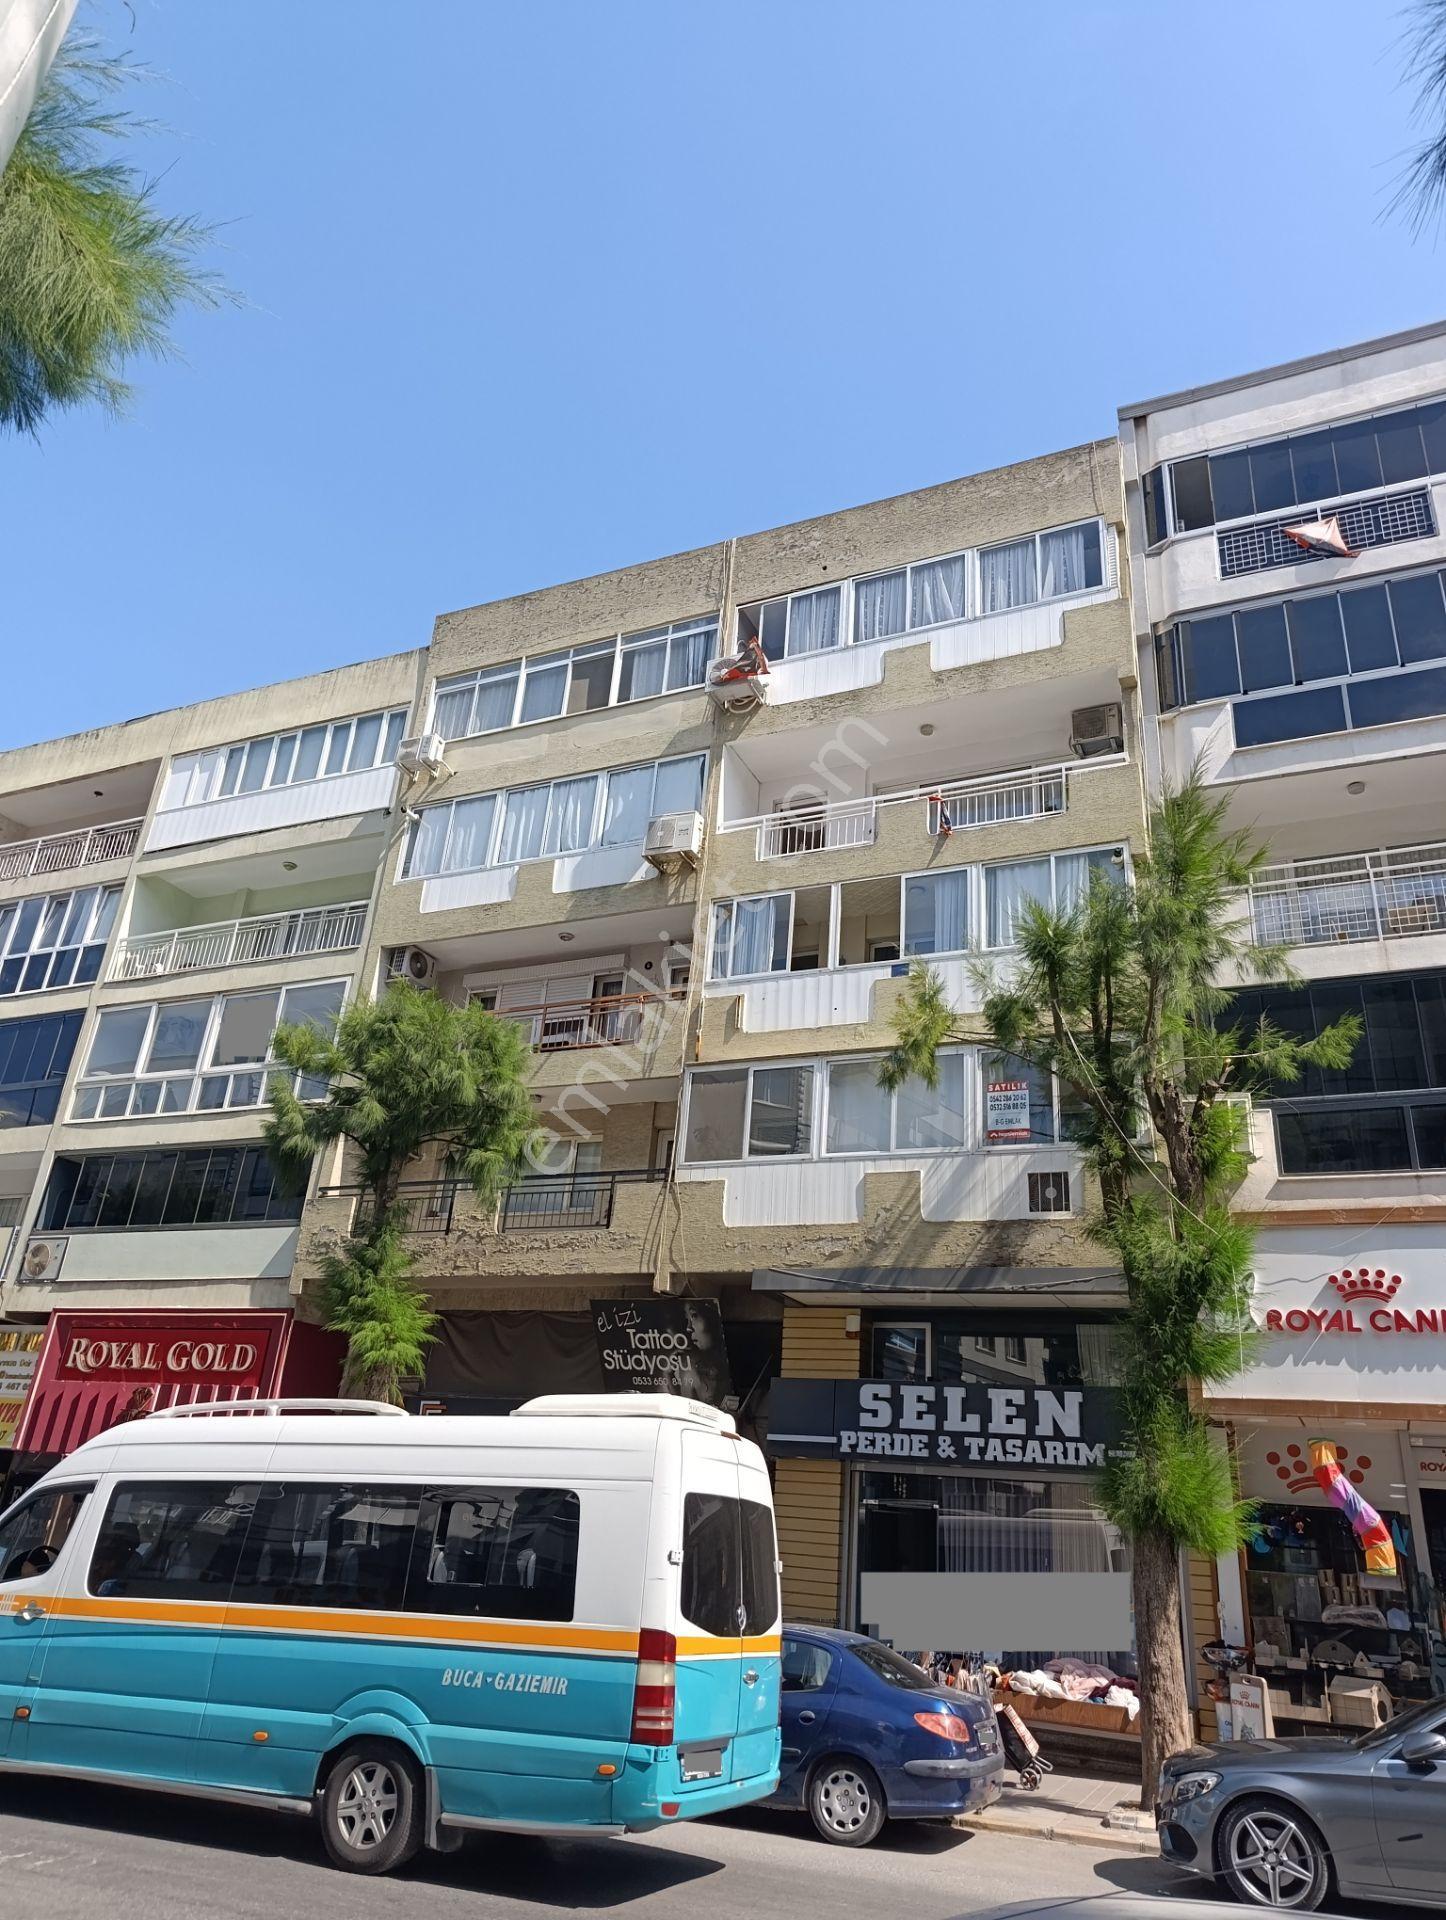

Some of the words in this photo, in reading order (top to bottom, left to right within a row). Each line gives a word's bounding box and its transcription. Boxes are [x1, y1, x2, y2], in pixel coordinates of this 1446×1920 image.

[988, 1082, 1027, 1092] SATILIK
[989, 1103, 1002, 1111] 0532
[597, 1311, 613, 1332] el
[1266, 1309, 1362, 1333] ROYAL
[626, 1328, 688, 1349] Tattoo
[65, 1337, 162, 1373] ROYAL
[166, 1340, 258, 1372] GOLD
[603, 1349, 692, 1375] Stüdyosu
[632, 1376, 652, 1386] 0533
[653, 1377, 668, 1386] 650
[859, 1383, 1083, 1438] SELEN
[839, 1430, 929, 1458] PERDE
[936, 1435, 958, 1459] &
[964, 1436, 1106, 1467] TASARIM
[441, 1668, 484, 1688] BUCA
